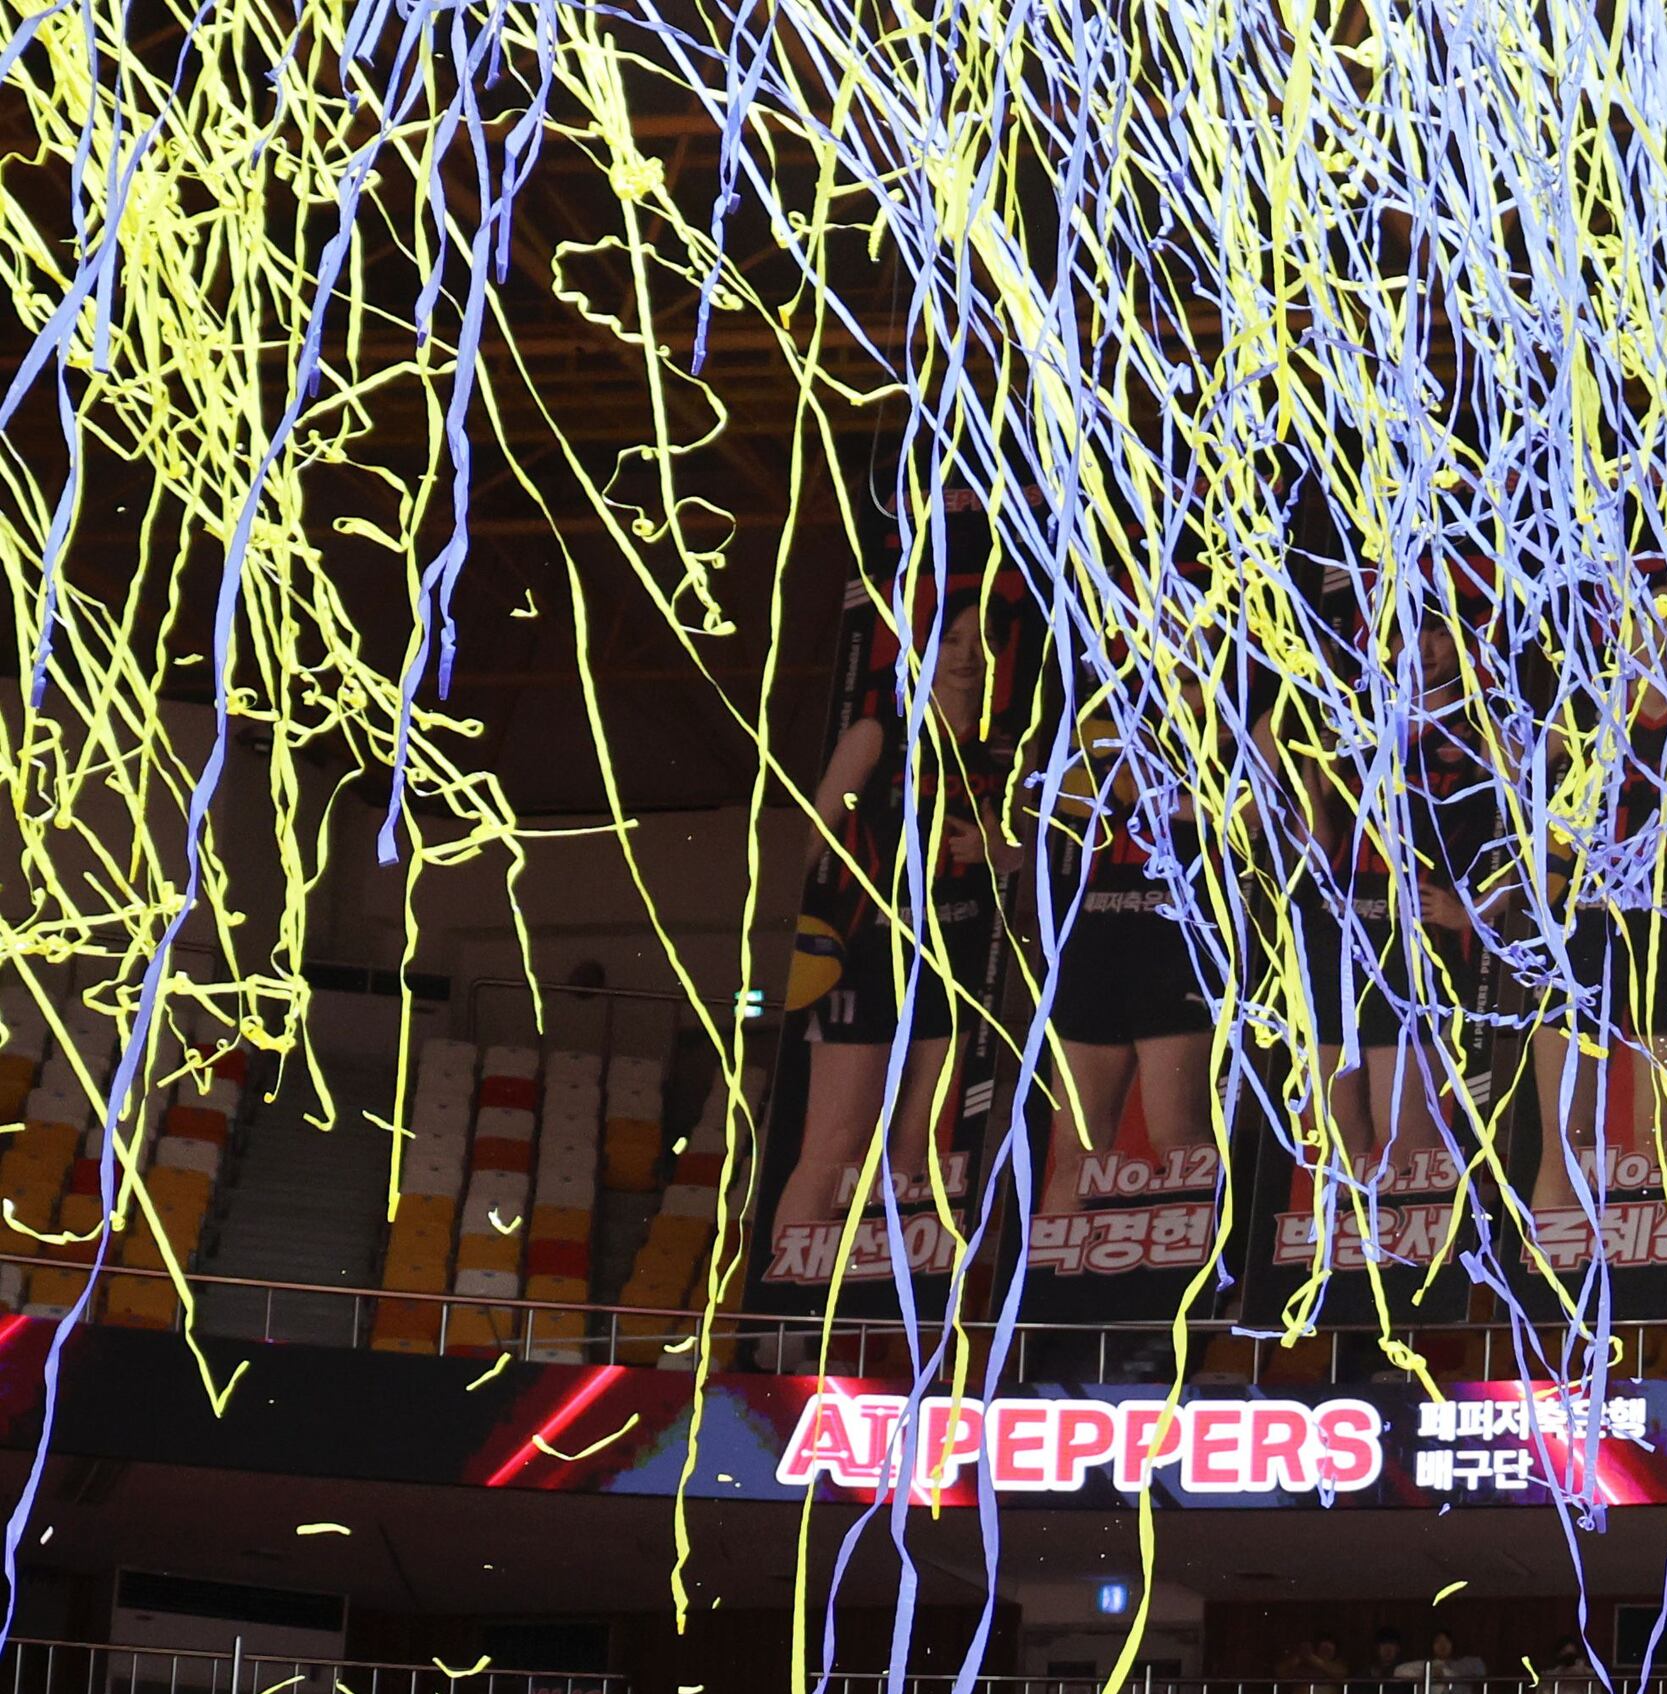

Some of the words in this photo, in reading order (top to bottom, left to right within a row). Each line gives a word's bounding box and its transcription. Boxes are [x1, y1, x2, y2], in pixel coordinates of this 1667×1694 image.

[1076, 1145, 1219, 1199] No.12
[765, 1211, 966, 1284] 채선아
[1028, 1205, 1215, 1273] 박경현
[777, 1393, 918, 1487] AI
[921, 1393, 1383, 1494] PEPPERS
[1415, 1446, 1530, 1489] 배구단
